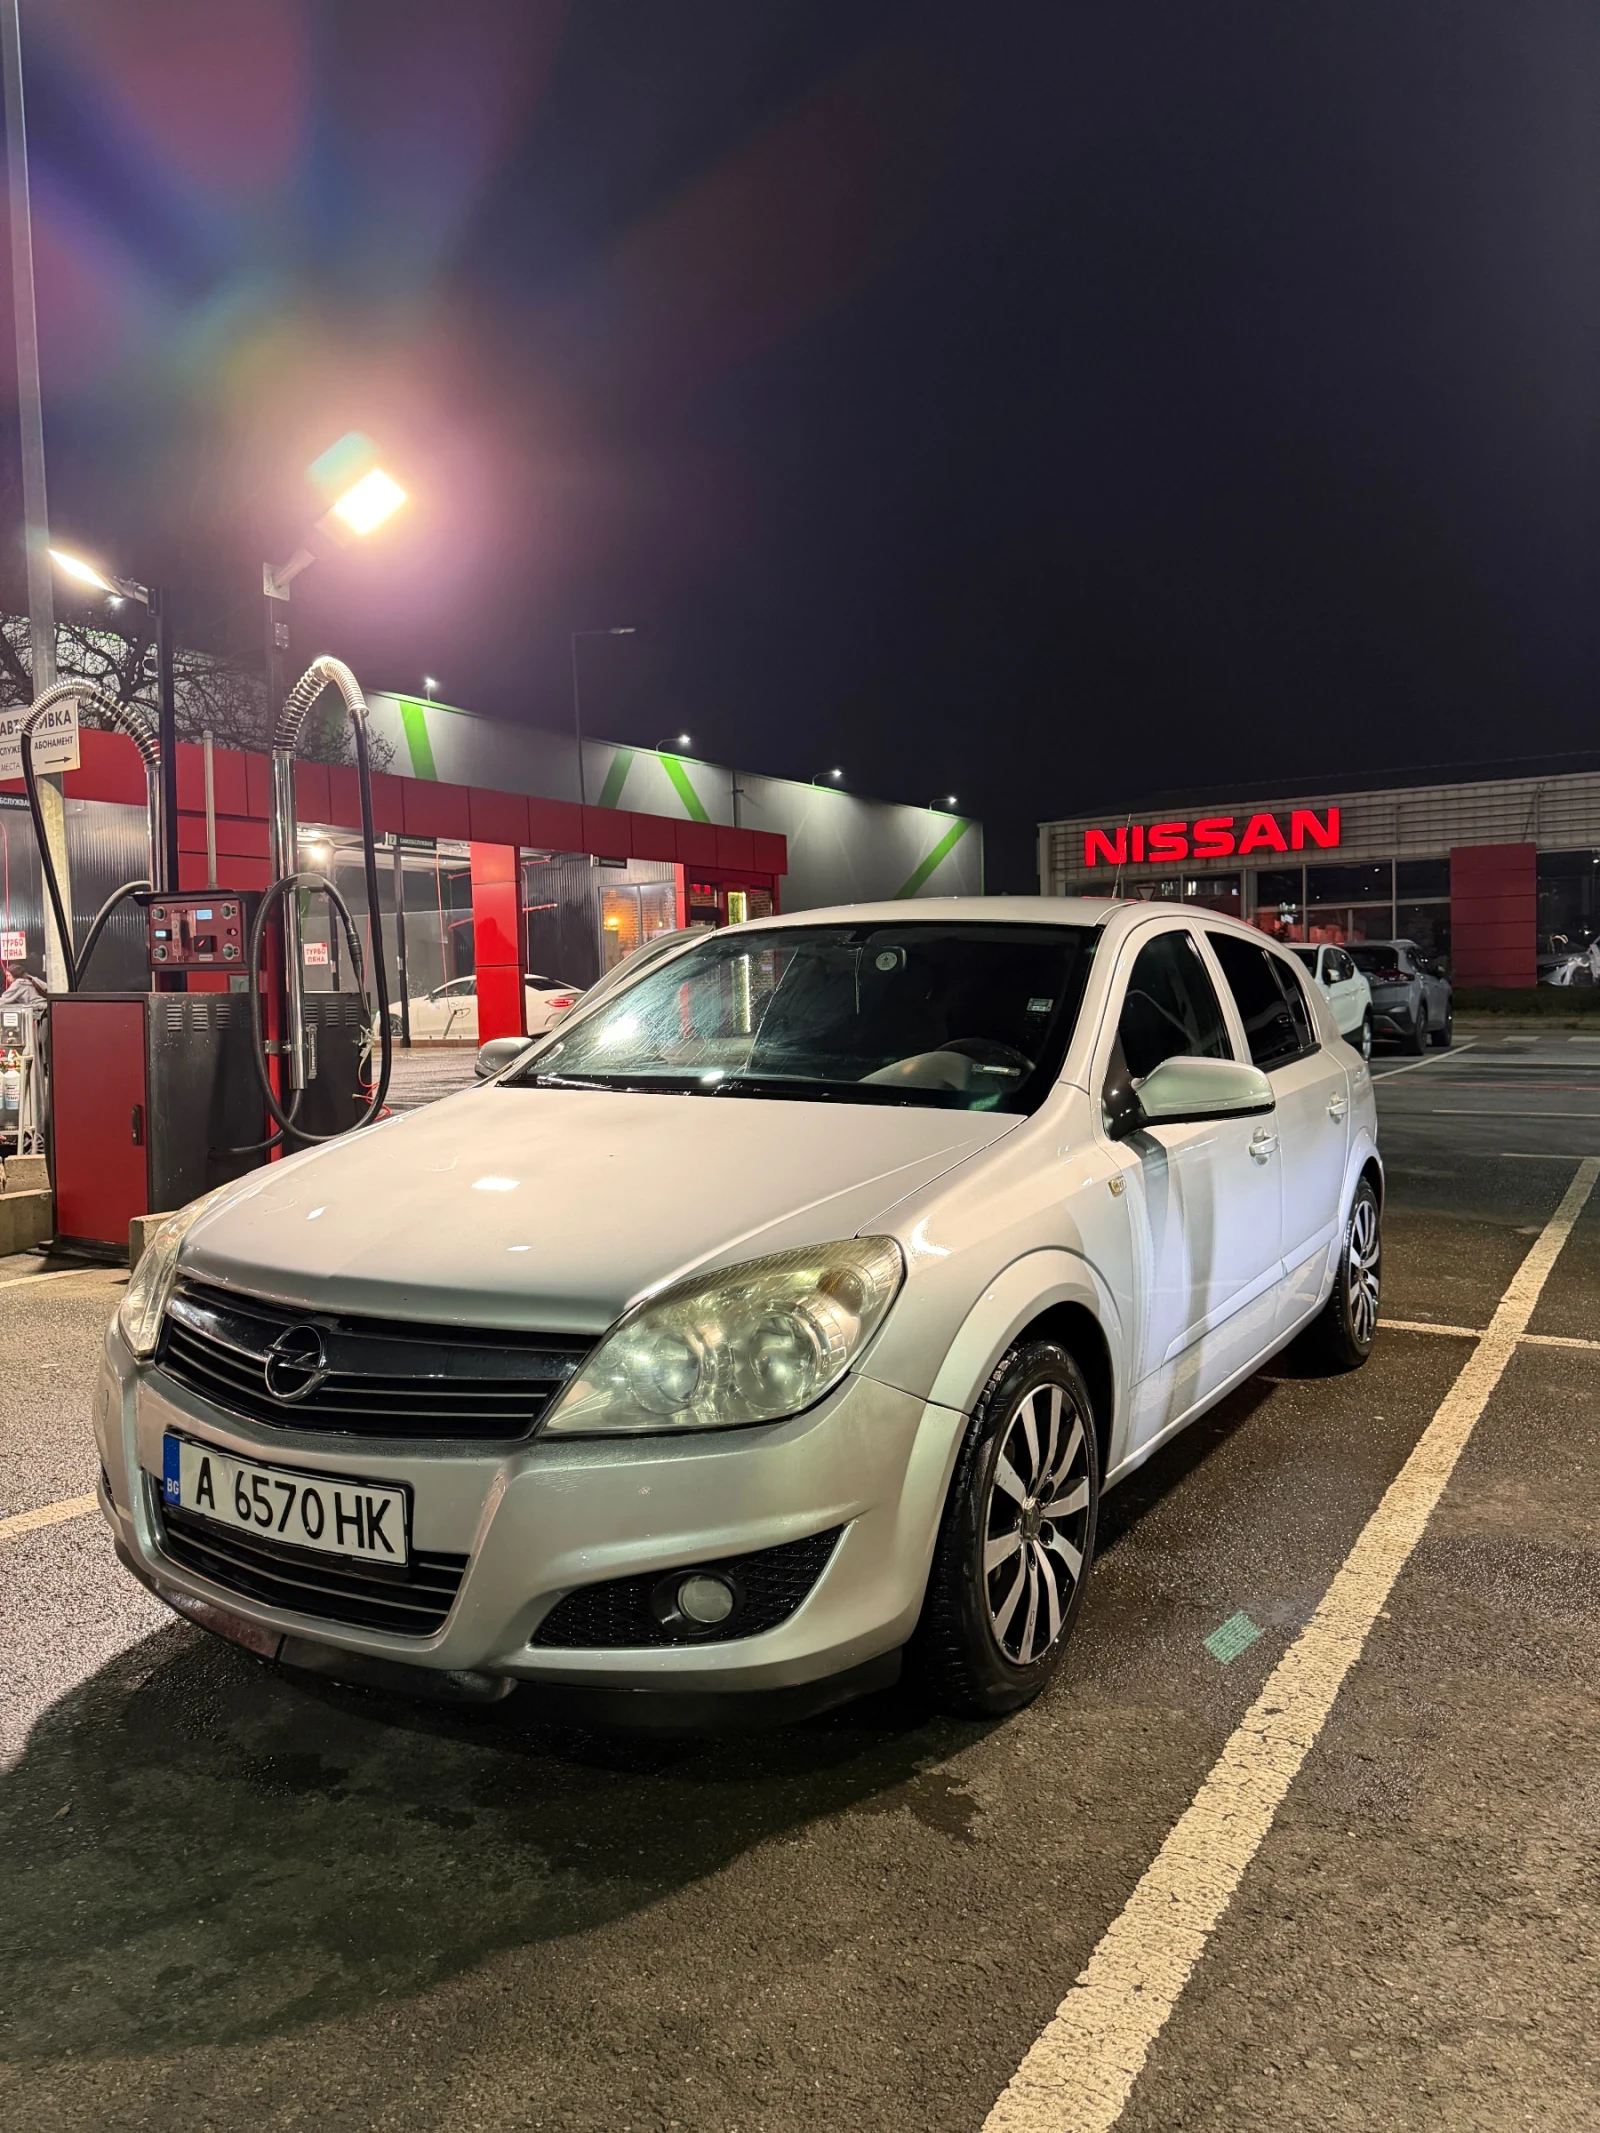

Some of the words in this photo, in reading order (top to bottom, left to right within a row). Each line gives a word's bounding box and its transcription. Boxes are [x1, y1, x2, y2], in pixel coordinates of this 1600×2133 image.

[0, 709, 72, 737] АВТИВКА
[34, 736, 73, 751] АБОНАМЕНТ
[1084, 807, 1340, 868] NISSAN
[2, 938, 24, 947] ТУРБО
[4, 949, 23, 957] ПЯНА
[166, 1477, 180, 1495] BG
[196, 1457, 215, 1510] A
[235, 1470, 325, 1540] 6570
[334, 1491, 395, 1553] HK
